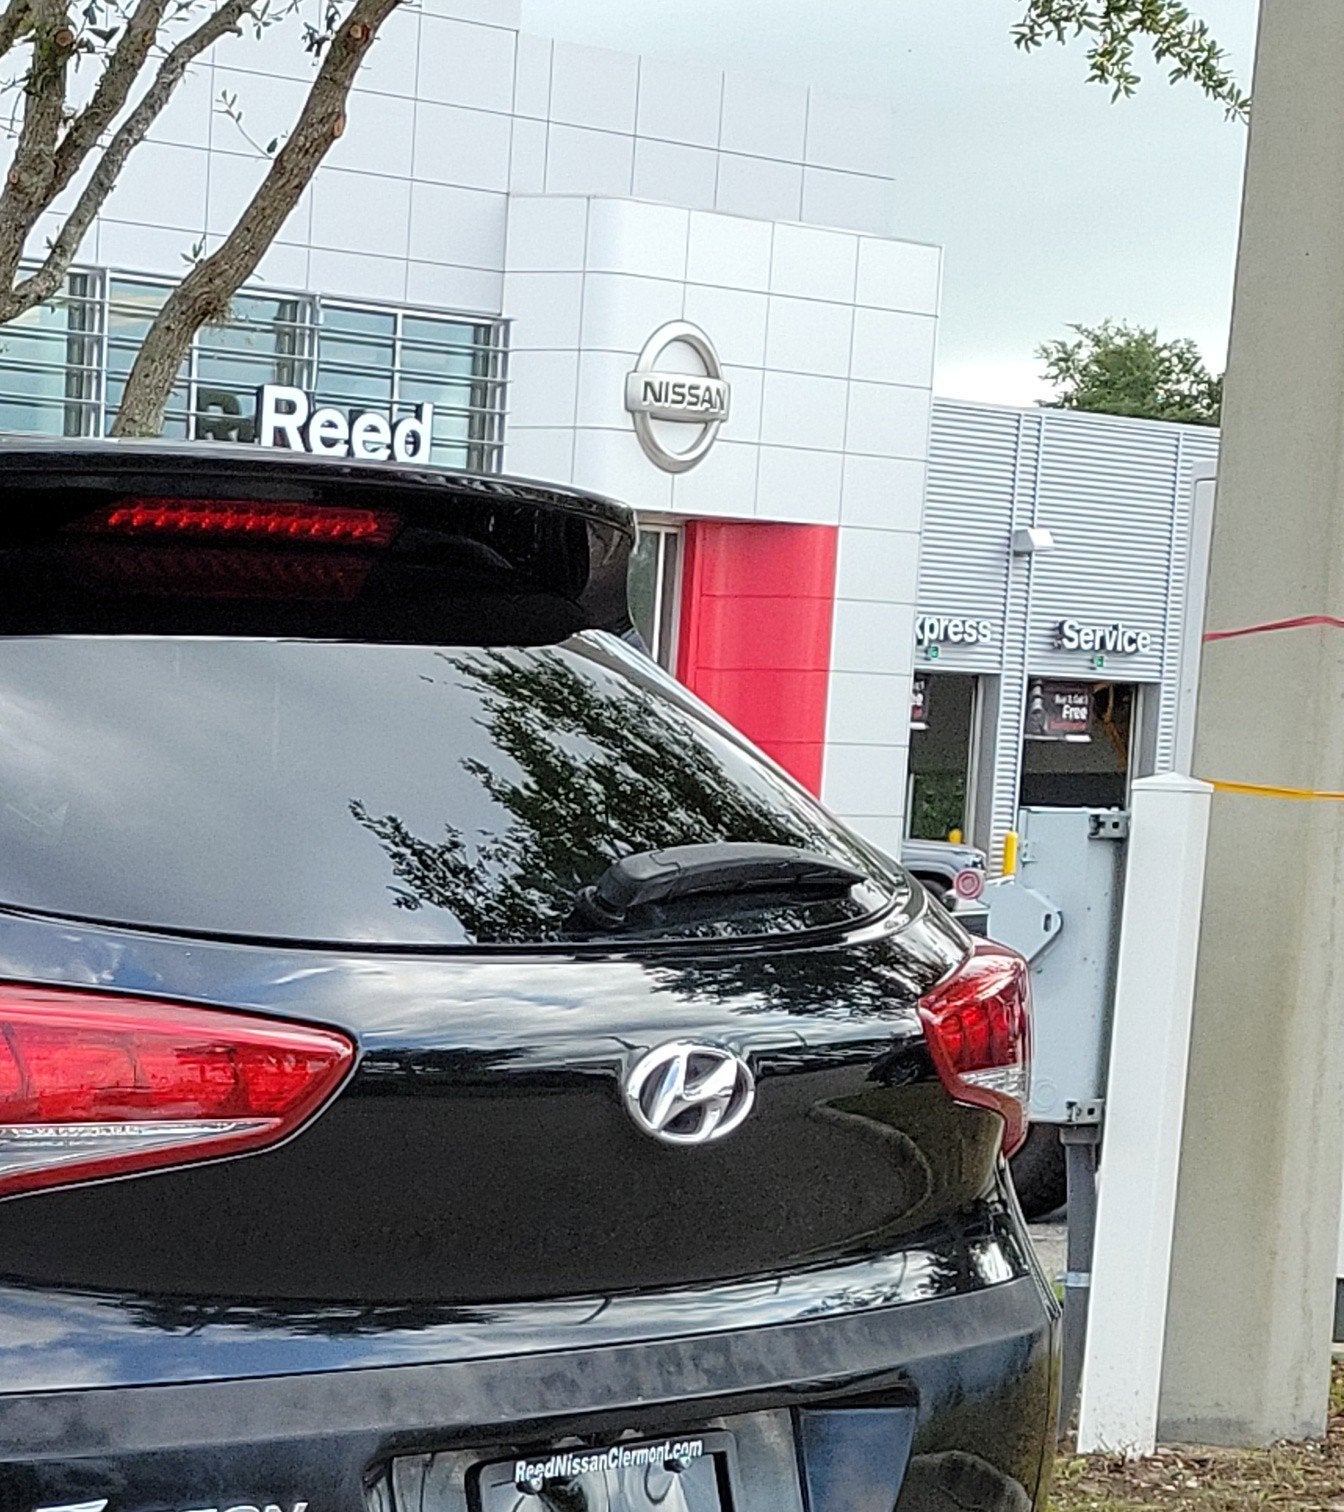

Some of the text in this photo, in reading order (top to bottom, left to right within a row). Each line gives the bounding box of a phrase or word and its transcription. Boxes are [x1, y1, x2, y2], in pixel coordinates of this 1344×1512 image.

[642, 380, 726, 412] NISSAN
[260, 384, 434, 464] Reed
[1063, 619, 1152, 653] Service
[514, 1440, 703, 1483] ReedNissanClermont.com
